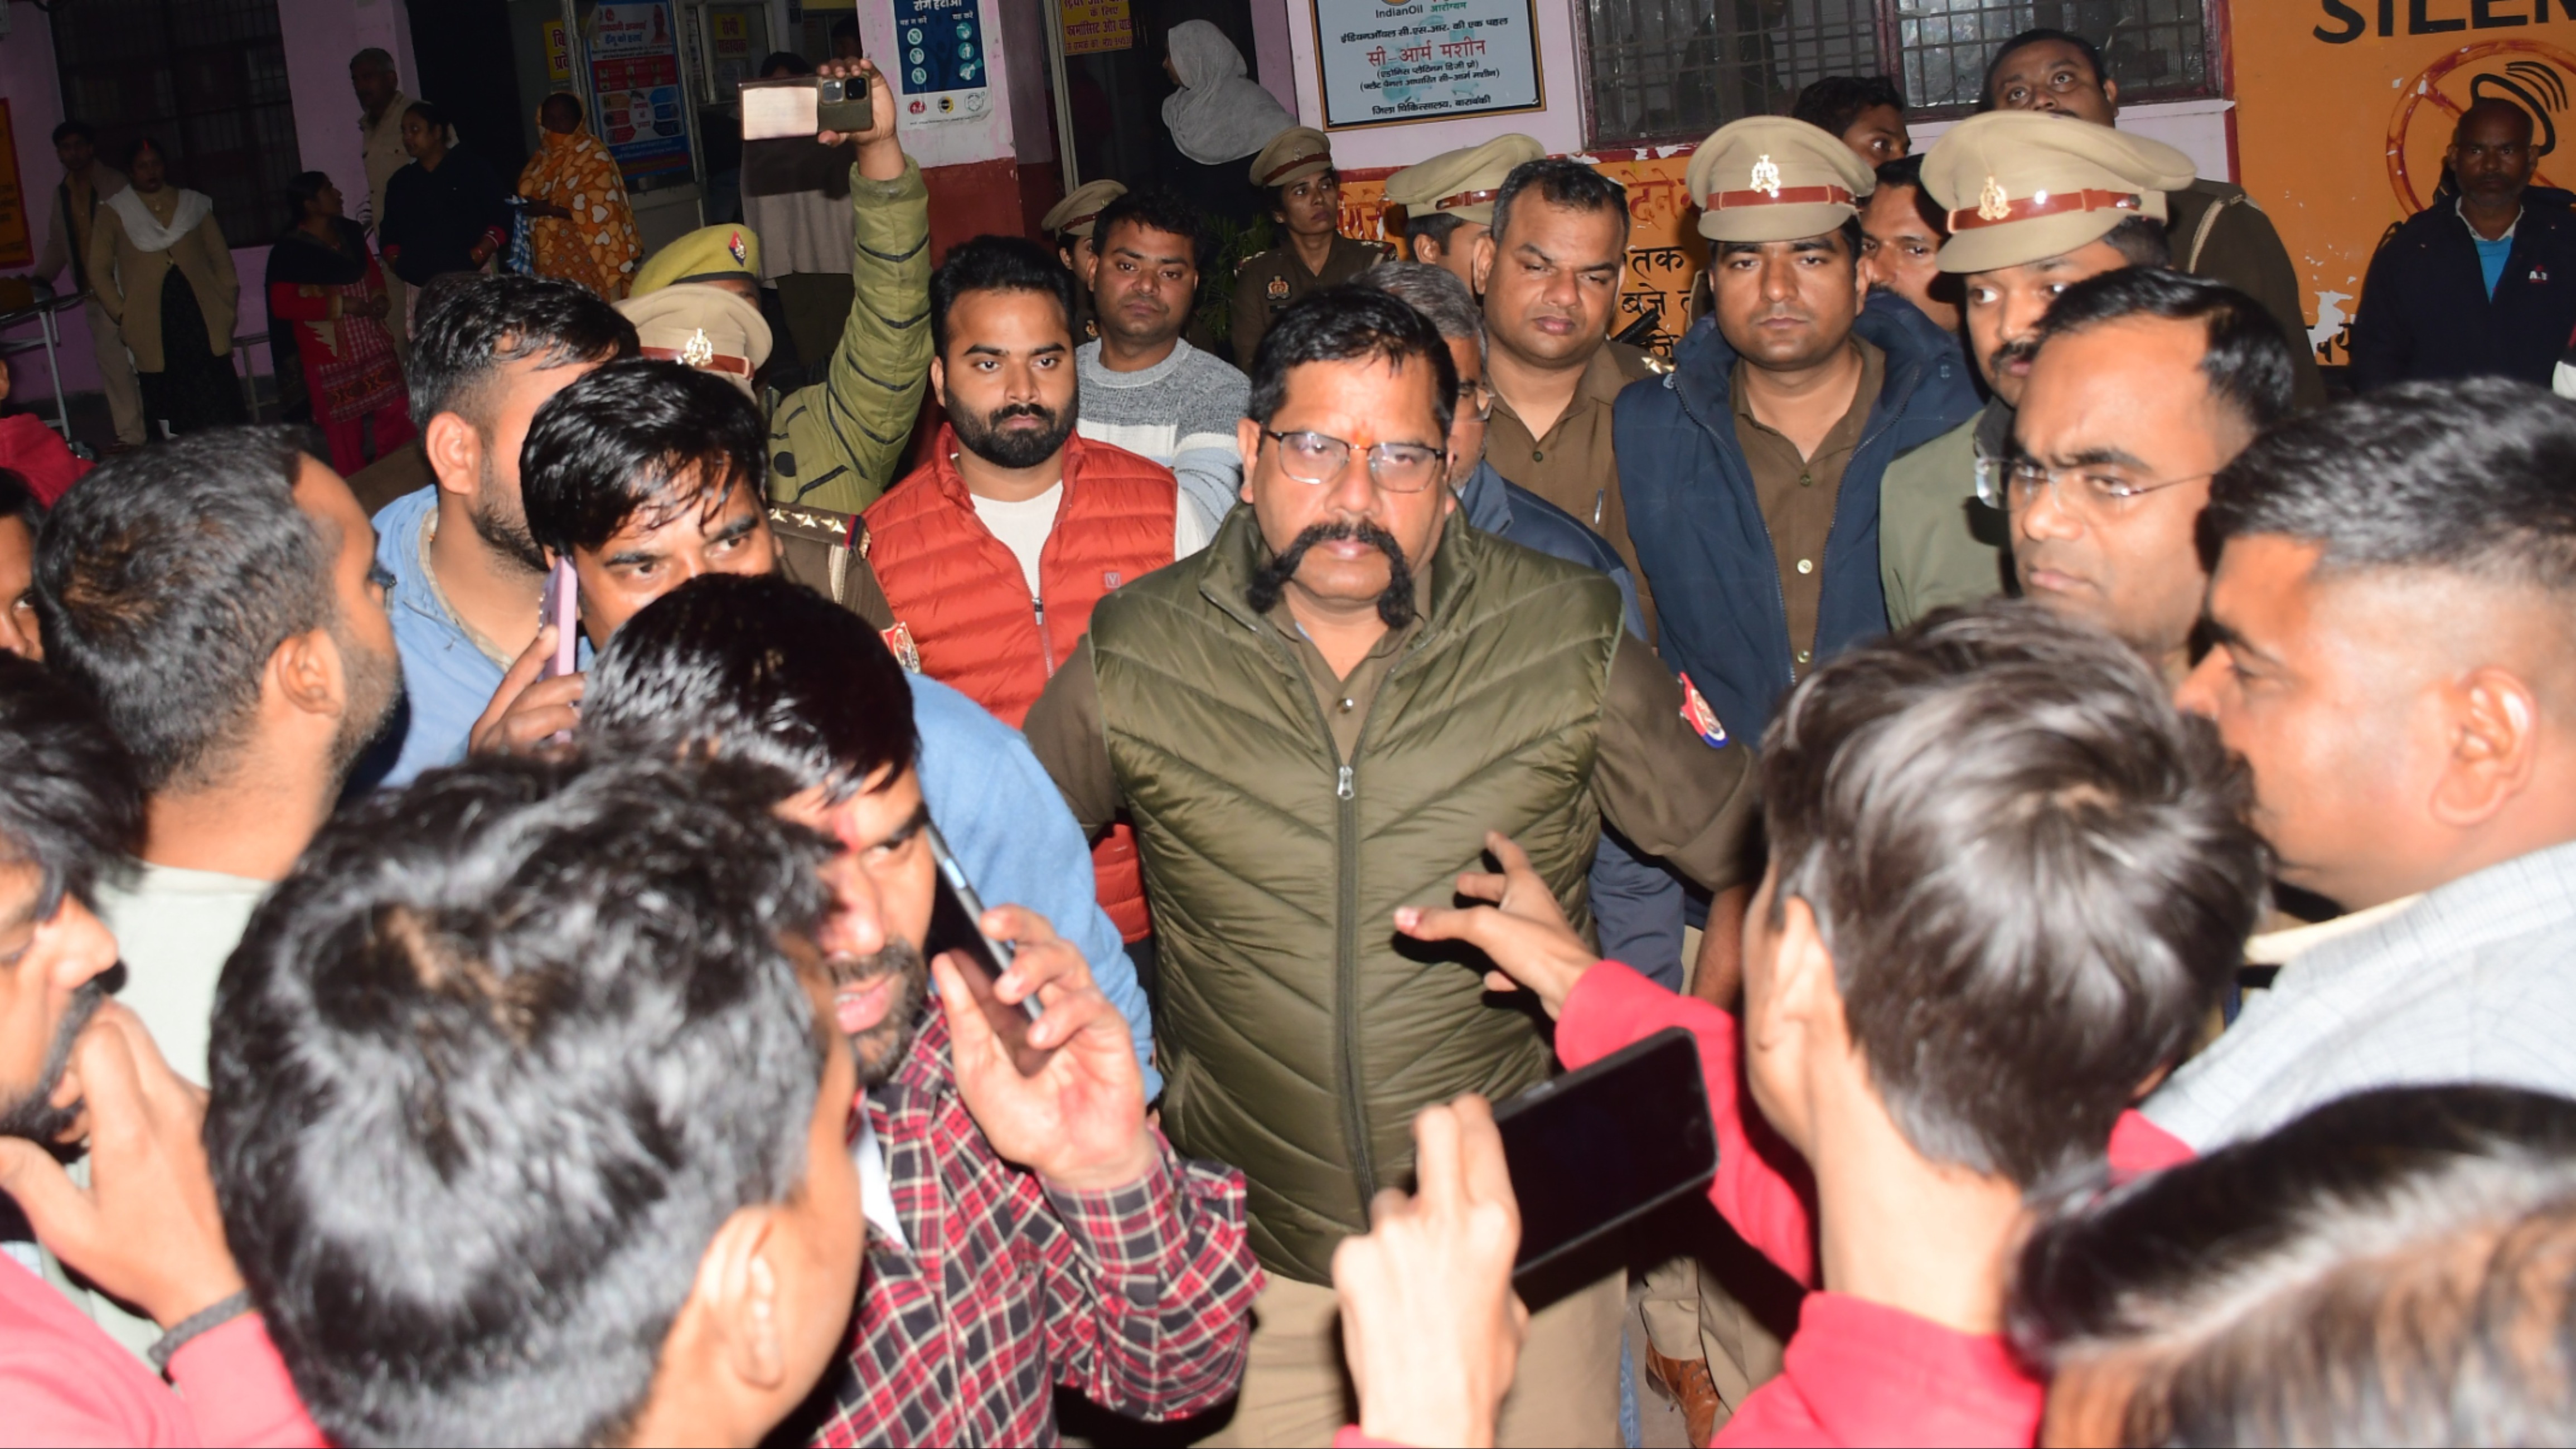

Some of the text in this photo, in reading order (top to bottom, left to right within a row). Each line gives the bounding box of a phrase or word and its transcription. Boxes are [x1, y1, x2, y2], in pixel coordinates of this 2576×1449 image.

[1376, 4, 1423, 18] IndianOil
[1452, 20, 1465, 29] की
[1486, 18, 1508, 26] पहल
[1439, 36, 1485, 58] मशीन
[1630, 246, 1684, 280] तक
